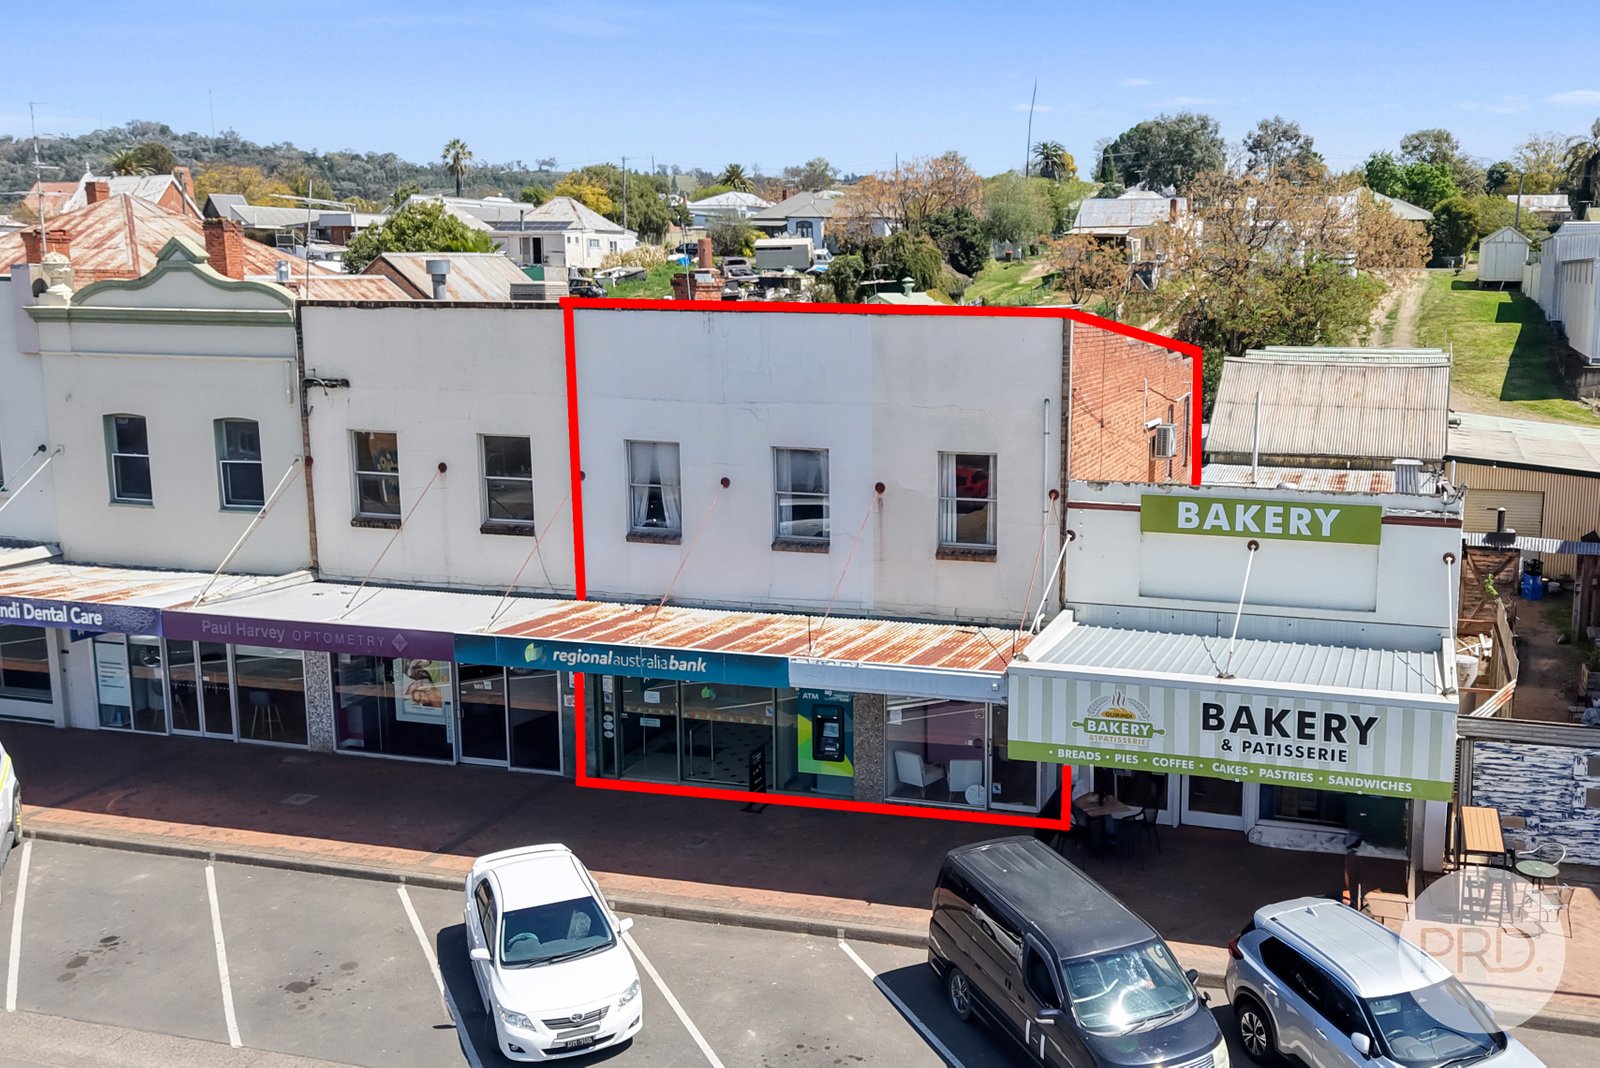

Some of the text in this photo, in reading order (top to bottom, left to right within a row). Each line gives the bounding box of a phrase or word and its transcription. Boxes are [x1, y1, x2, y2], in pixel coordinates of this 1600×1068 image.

[1177, 501, 1341, 537] BAKERY
[23, 603, 68, 623] Dental
[70, 607, 103, 626] Care
[201, 619, 385, 648] Paul Harvey OPTOMETRY
[802, 692, 819, 701] ATM
[1087, 720, 1151, 737] BAKERY
[1202, 702, 1379, 746] BAKERY
[1221, 738, 1348, 764] & PATISSERIE
[1057, 748, 1413, 793] BREADS PIES COFFEE CAKES PASTRIES SANDWICHES
